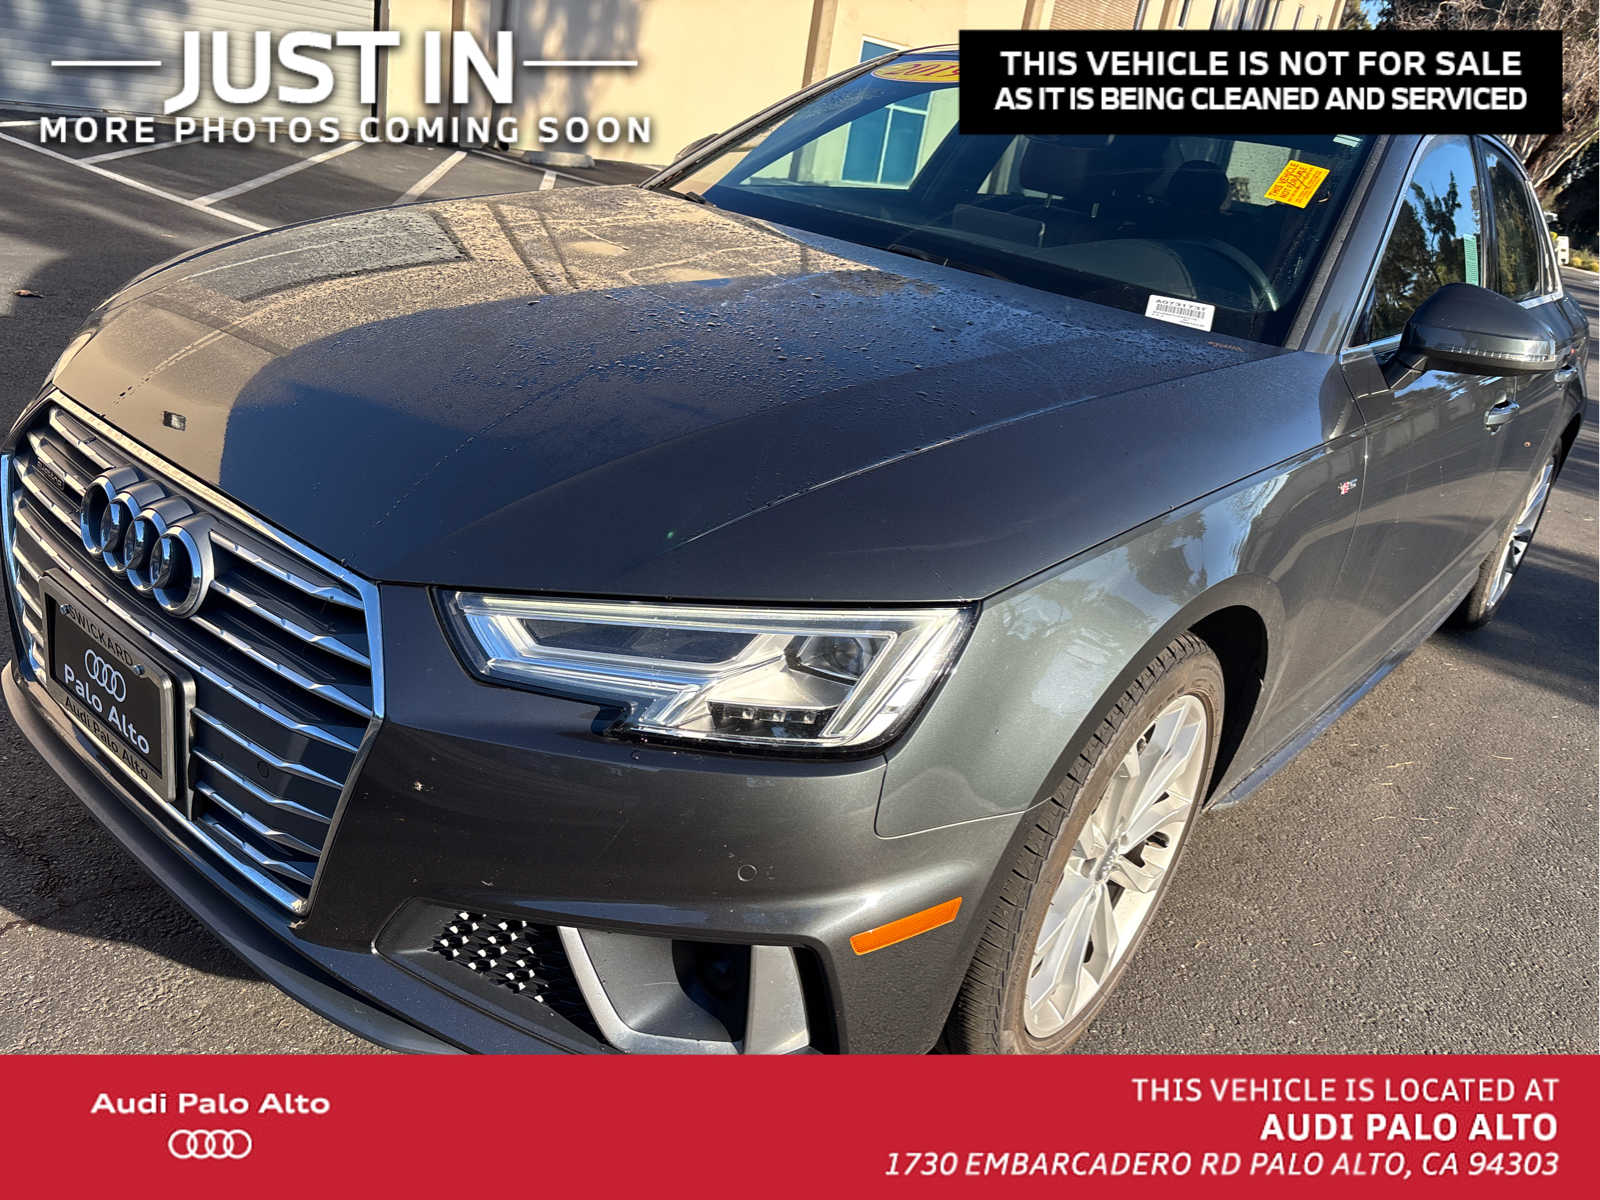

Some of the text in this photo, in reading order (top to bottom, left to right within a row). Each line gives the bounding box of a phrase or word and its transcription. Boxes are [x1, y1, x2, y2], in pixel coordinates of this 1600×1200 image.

[68, 604, 135, 667] SWICKARD
[64, 664, 150, 755] Palo Alto
[65, 696, 149, 780] Audi Palo Alto
